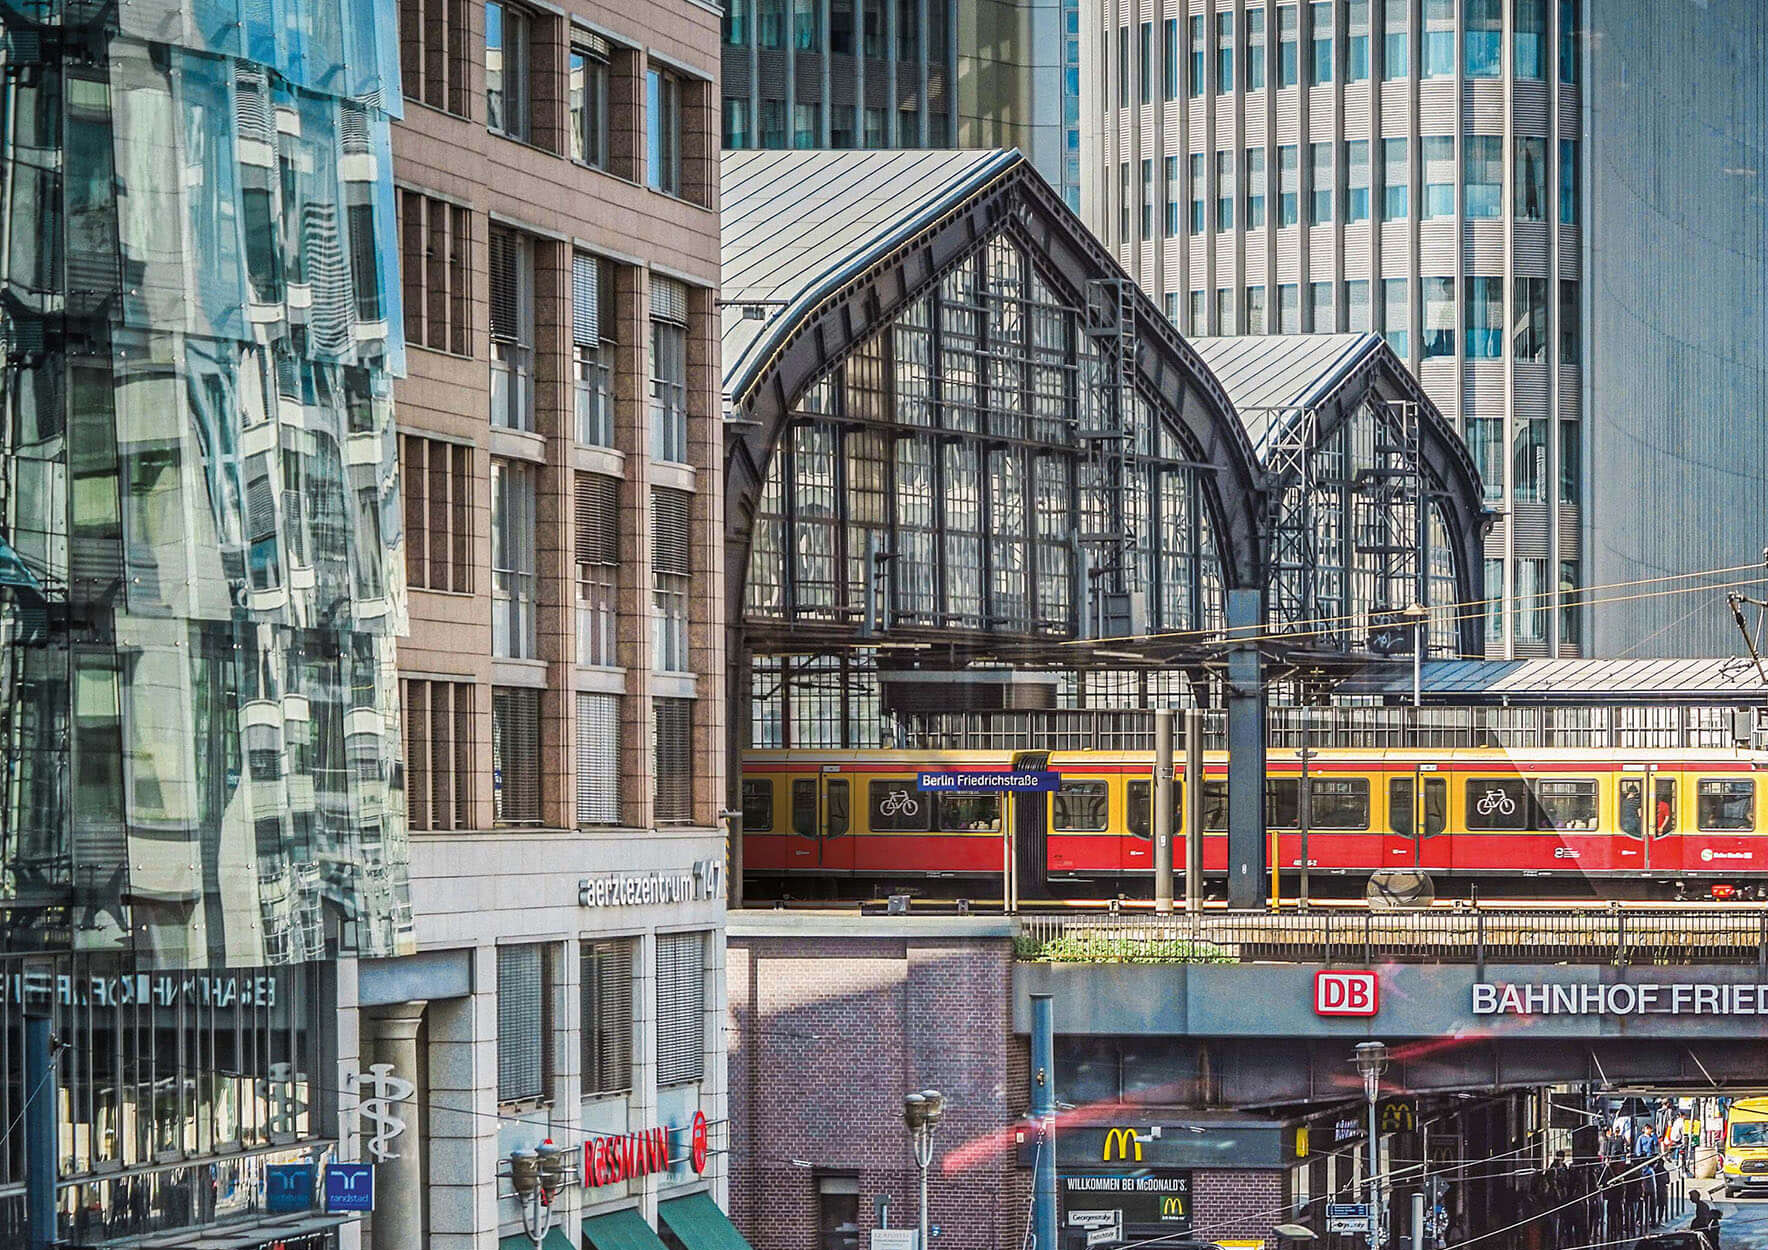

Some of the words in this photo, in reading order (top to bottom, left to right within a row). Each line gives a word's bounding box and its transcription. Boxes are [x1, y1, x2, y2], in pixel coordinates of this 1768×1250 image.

[922, 775, 955, 786] Berlin
[957, 774, 1039, 786] Friedrichstraße
[580, 871, 693, 907] aerztezentrum
[1325, 979, 1369, 1008] DB
[1472, 985, 1659, 1015] BAHNHOF
[584, 1126, 669, 1188] ROSSMANN
[330, 1192, 368, 1202] randstad
[1067, 1178, 1120, 1190] WILLKOMMEN
[1122, 1179, 1135, 1190] BEI
